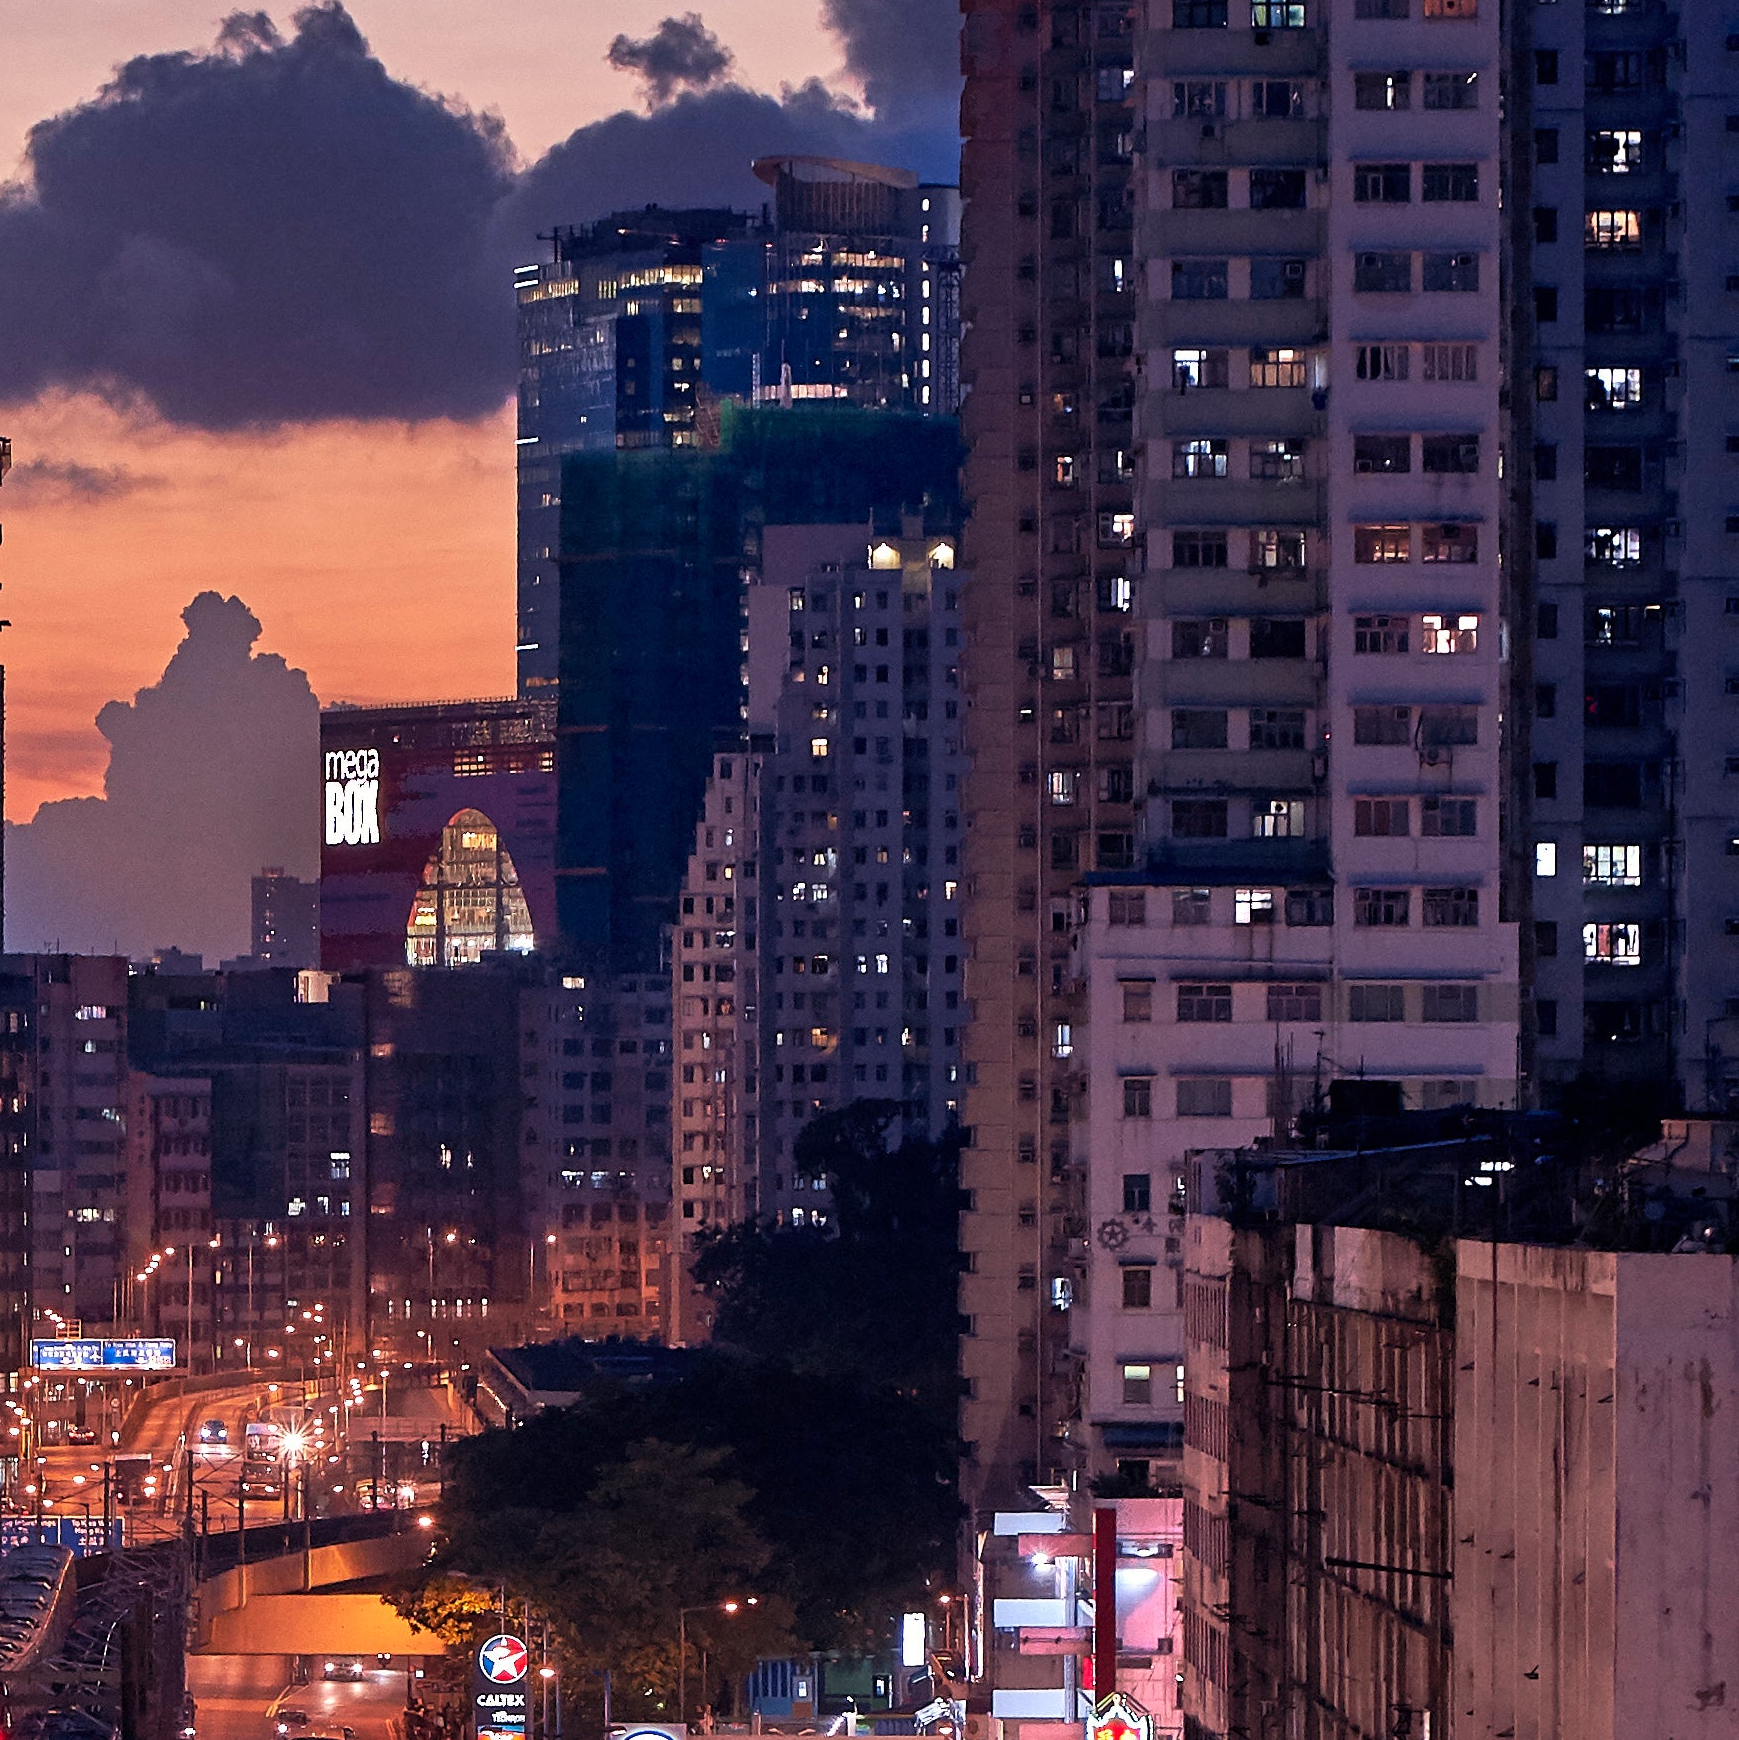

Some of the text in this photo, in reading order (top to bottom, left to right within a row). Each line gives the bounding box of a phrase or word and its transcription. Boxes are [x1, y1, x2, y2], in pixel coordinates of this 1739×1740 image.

[324, 747, 380, 786] mega
[324, 780, 381, 846] BOX
[476, 1694, 526, 1707] CALTEX
